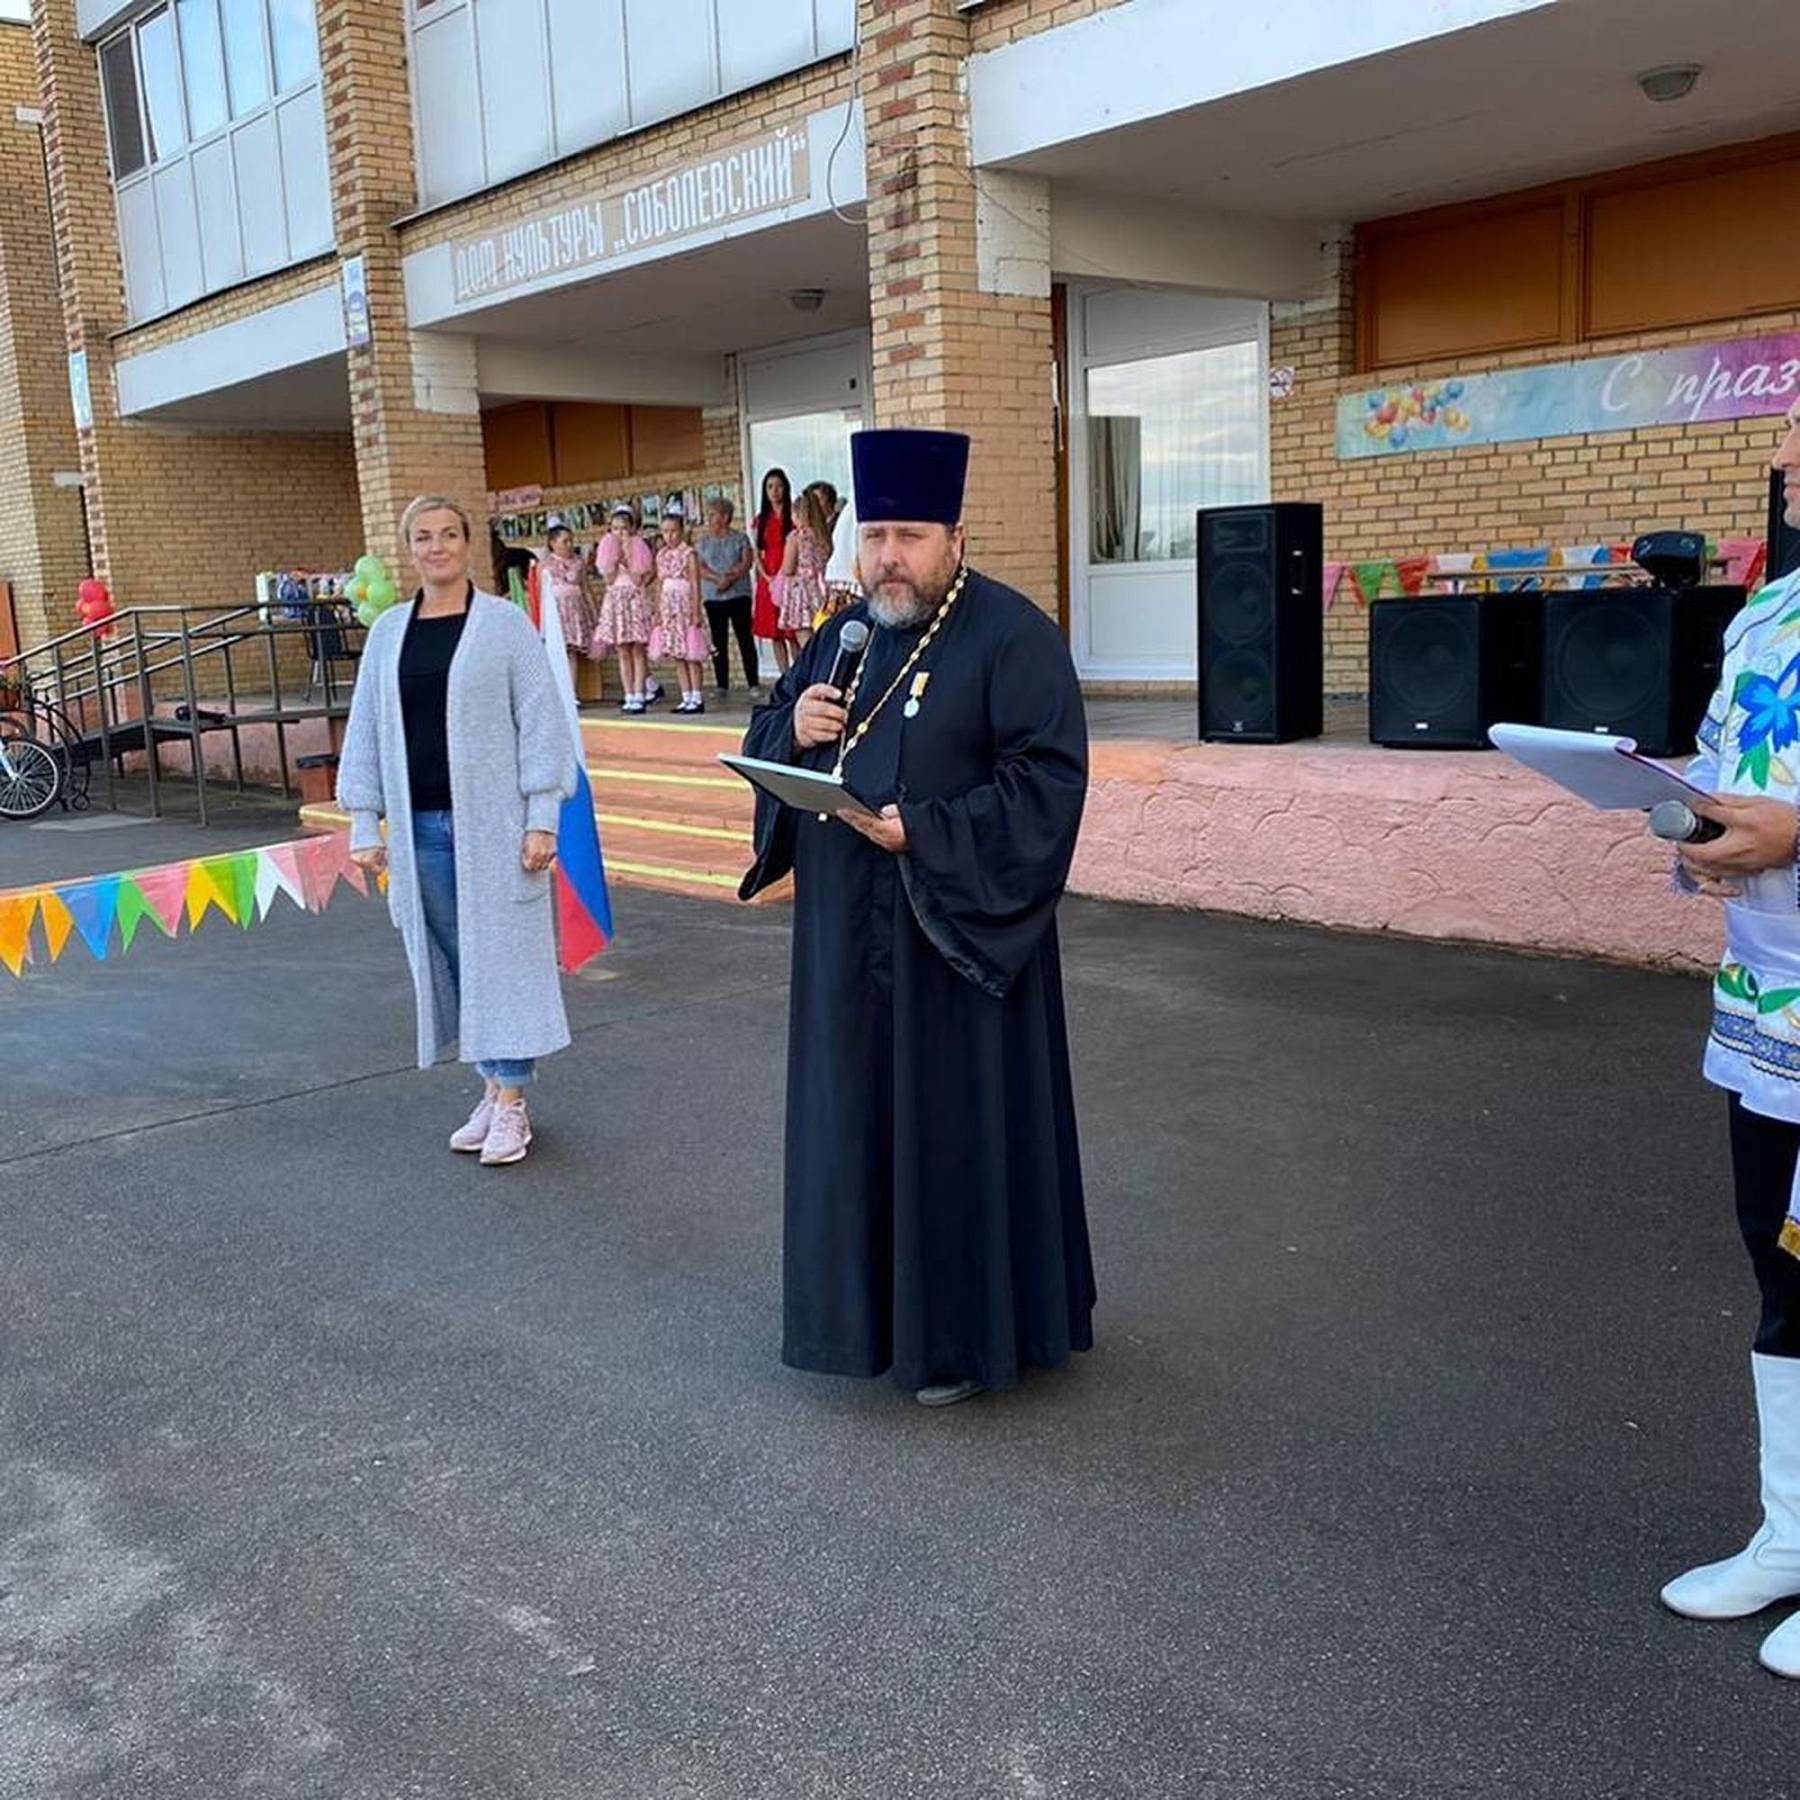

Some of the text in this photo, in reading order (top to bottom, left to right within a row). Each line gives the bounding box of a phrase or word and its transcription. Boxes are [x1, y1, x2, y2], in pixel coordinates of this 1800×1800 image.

[457, 239, 497, 297] ДОМ
[503, 201, 604, 281] КУЛЬТУРЫ
[1603, 355, 1800, 421] С праз
